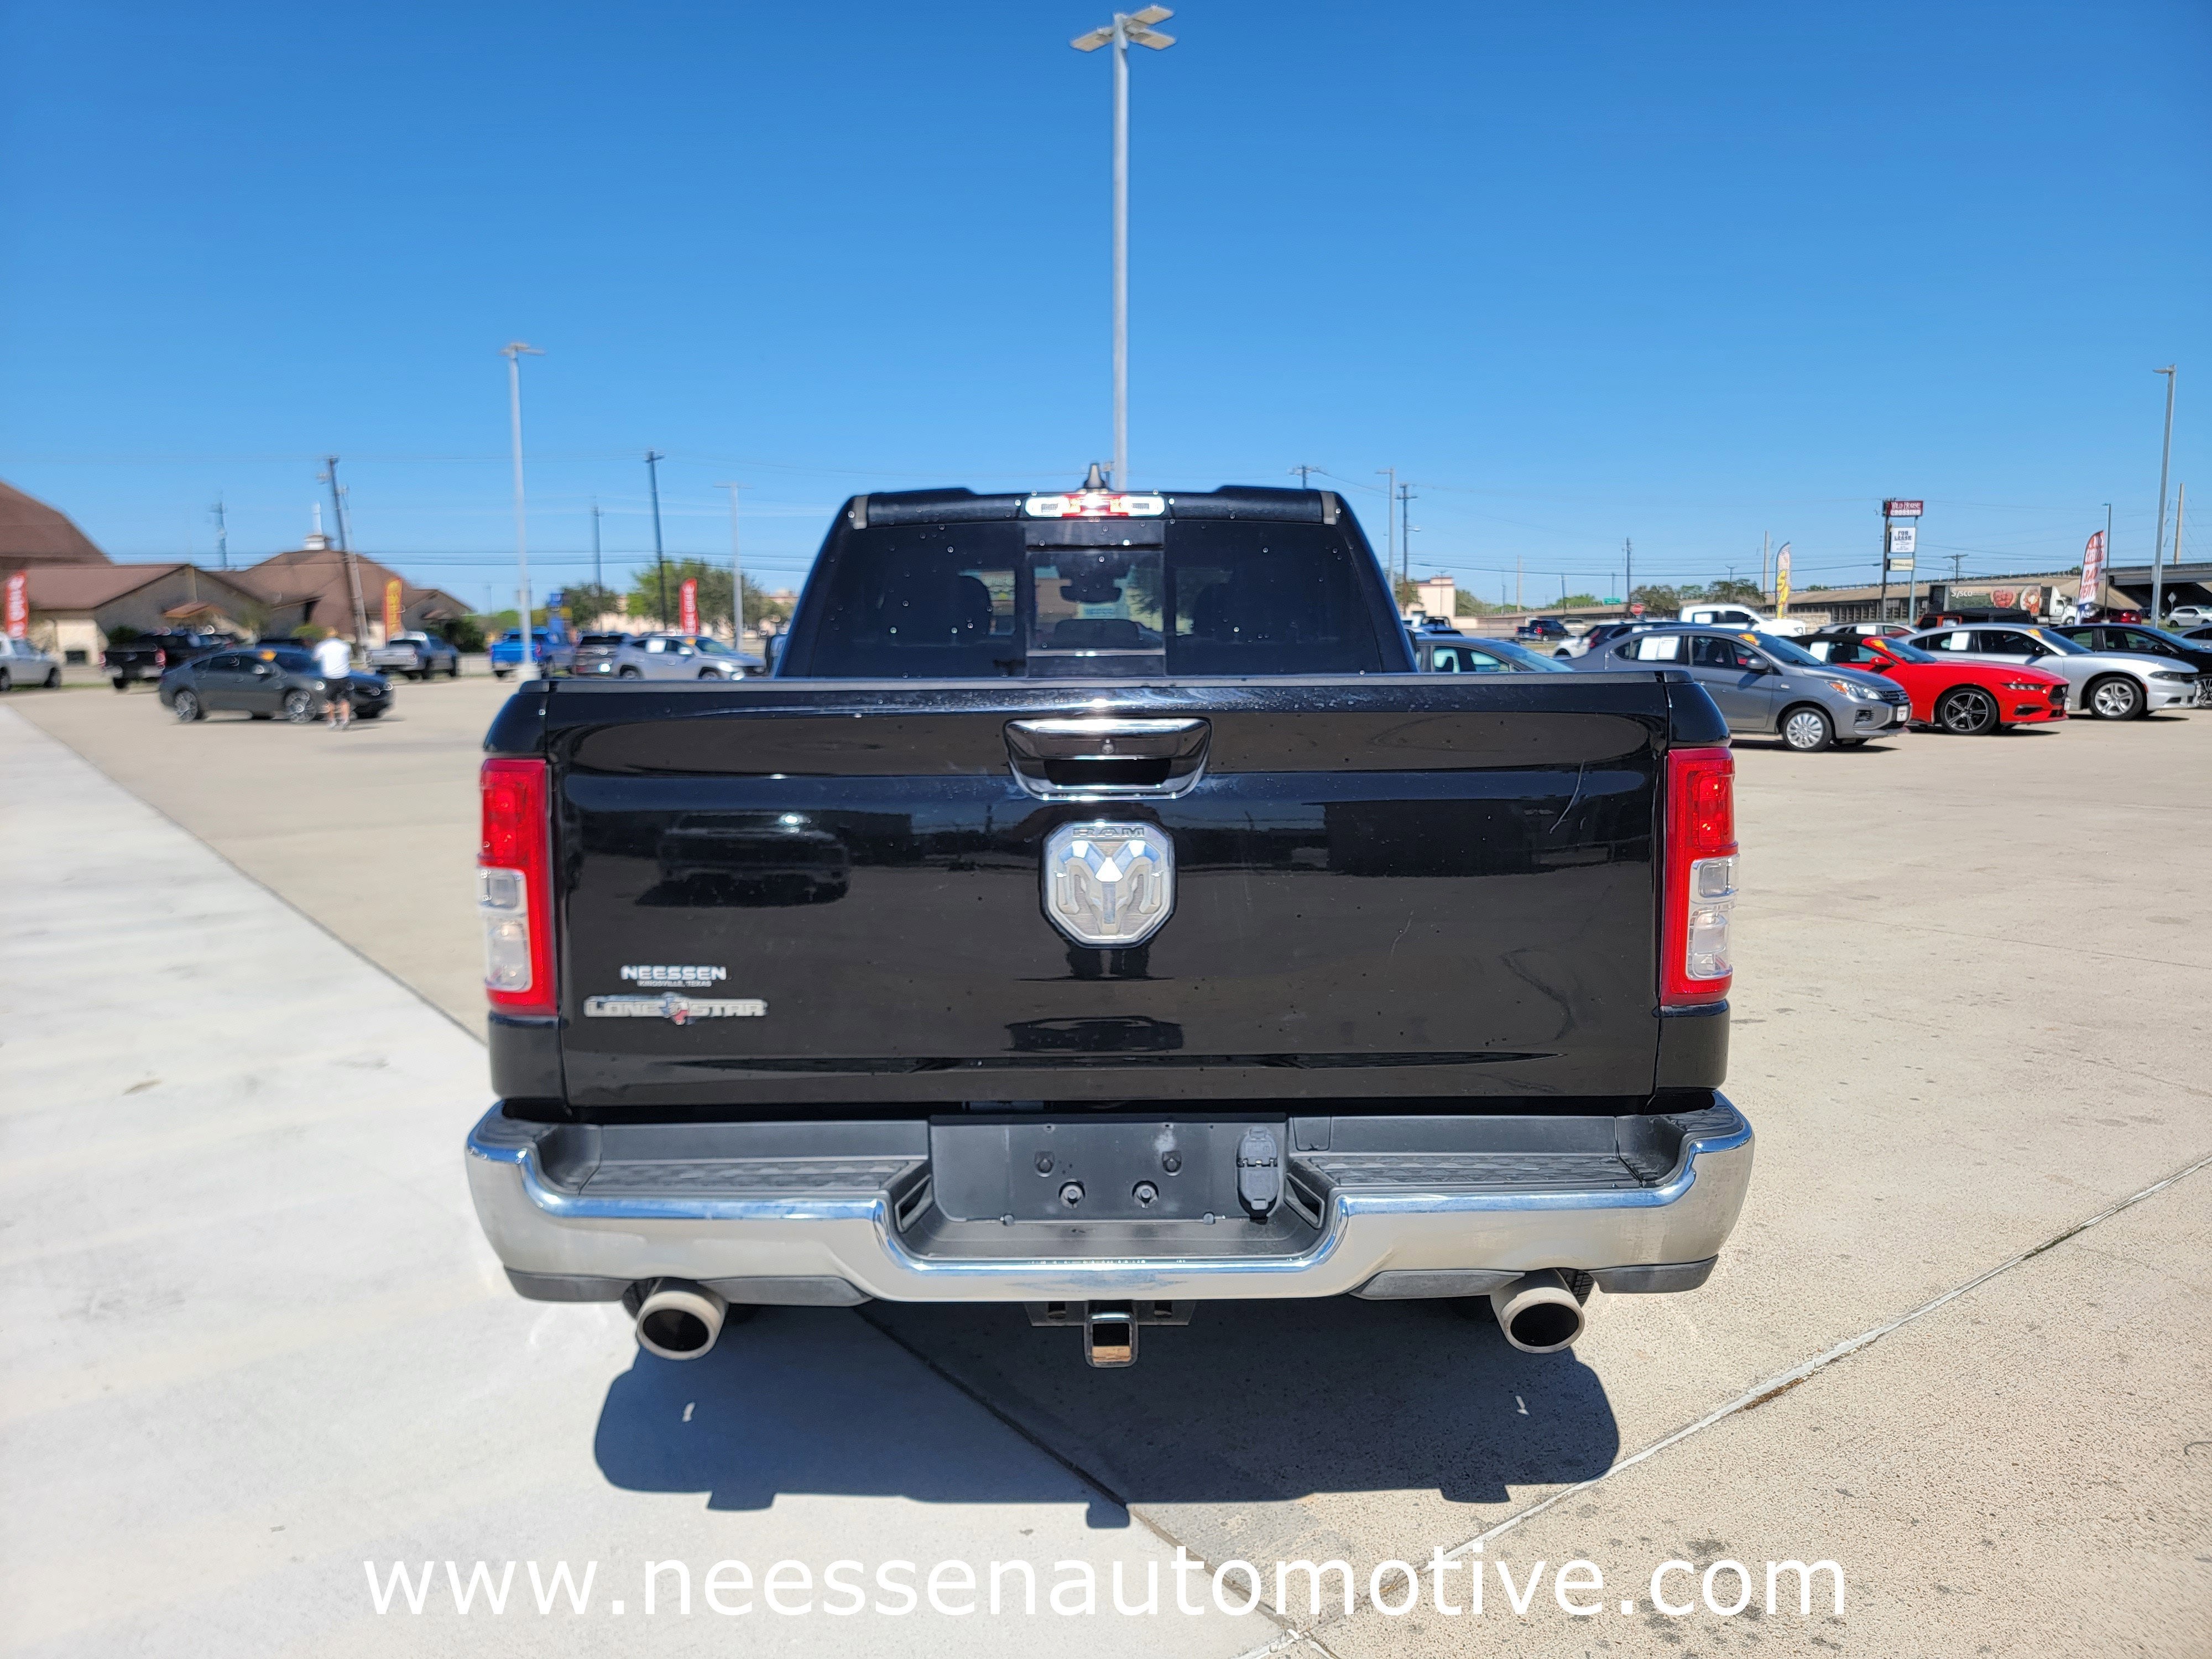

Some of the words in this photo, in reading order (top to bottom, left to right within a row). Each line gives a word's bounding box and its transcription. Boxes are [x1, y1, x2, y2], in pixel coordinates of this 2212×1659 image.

[1072, 827, 1145, 838] RAM
[620, 965, 727, 980] NEESSEN
[584, 997, 662, 1018] LONE
[690, 999, 768, 1018] STAR
